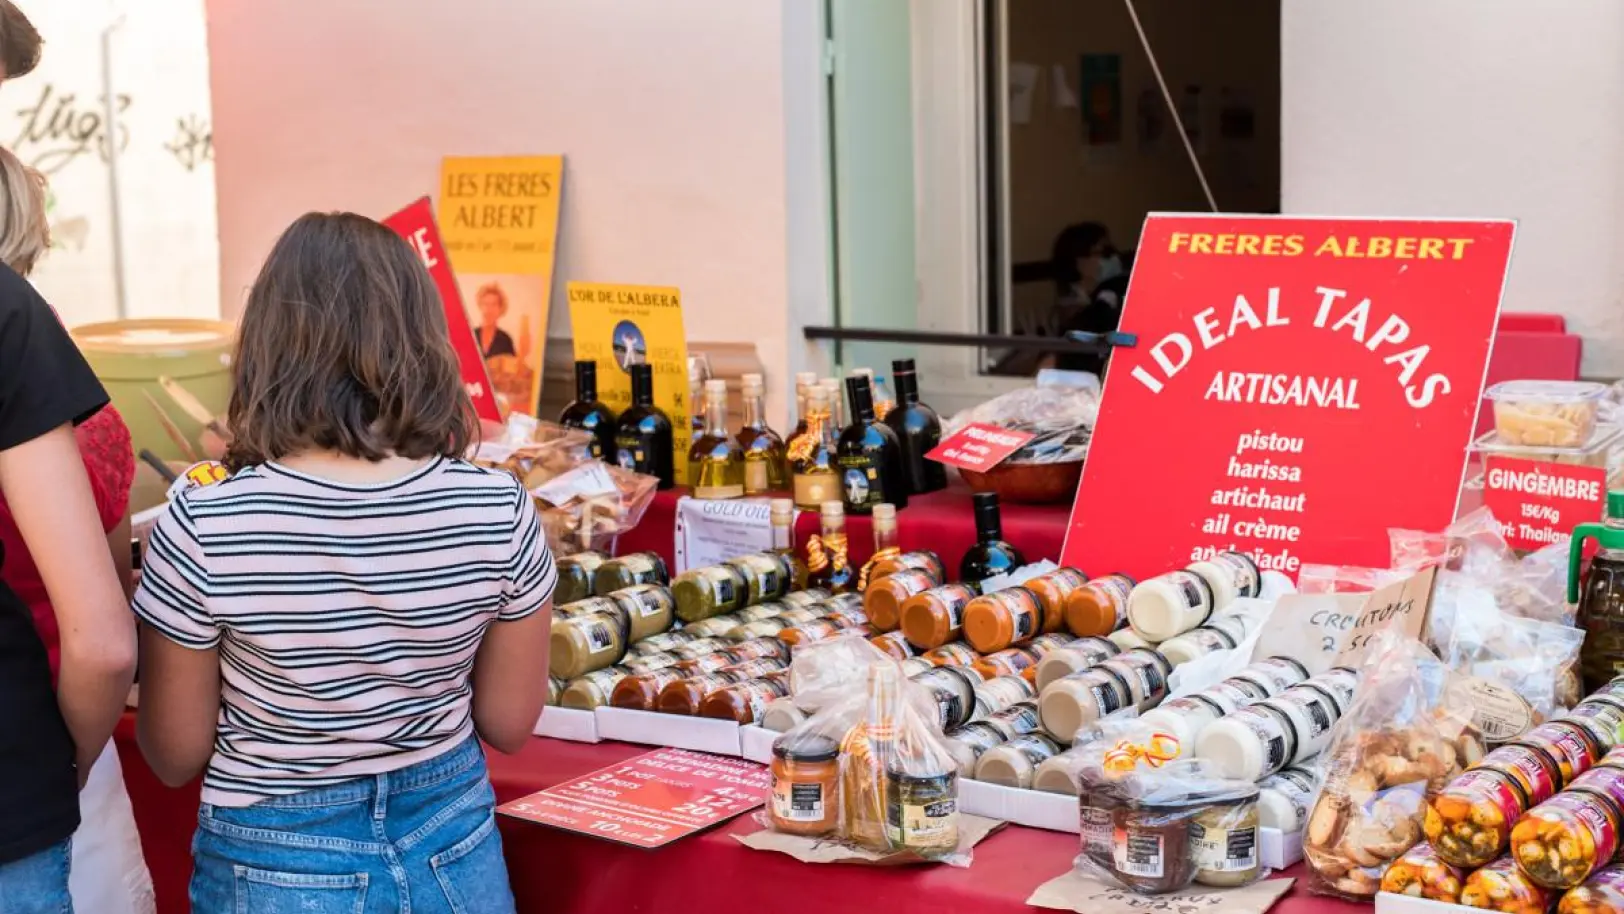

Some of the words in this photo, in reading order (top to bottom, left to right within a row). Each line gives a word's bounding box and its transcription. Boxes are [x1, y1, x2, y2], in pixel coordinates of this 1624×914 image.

[447, 173, 478, 198] LES
[484, 173, 552, 198] FRERES
[454, 204, 538, 229] ALBERT
[1168, 232, 1304, 256] FRERES
[1314, 235, 1474, 260] ALBERT
[569, 290, 594, 302] L'OR
[598, 292, 613, 304] DE
[617, 292, 680, 308] L'ALBERA
[1130, 287, 1290, 394] IDEAL
[1312, 286, 1452, 409] TAPAS
[1204, 371, 1361, 409] ARTISANAL
[1237, 430, 1304, 455] pistou
[1227, 456, 1302, 482] harissa
[1488, 468, 1600, 502] GINGEMBRE
[703, 501, 743, 516] GOLD
[1211, 487, 1306, 512] artichaut
[1520, 503, 1560, 524] 15€/Kg
[1202, 513, 1230, 535] ail
[1233, 518, 1300, 541] crème
[1519, 523, 1580, 544] Thailan
[1190, 545, 1300, 571] anïade
